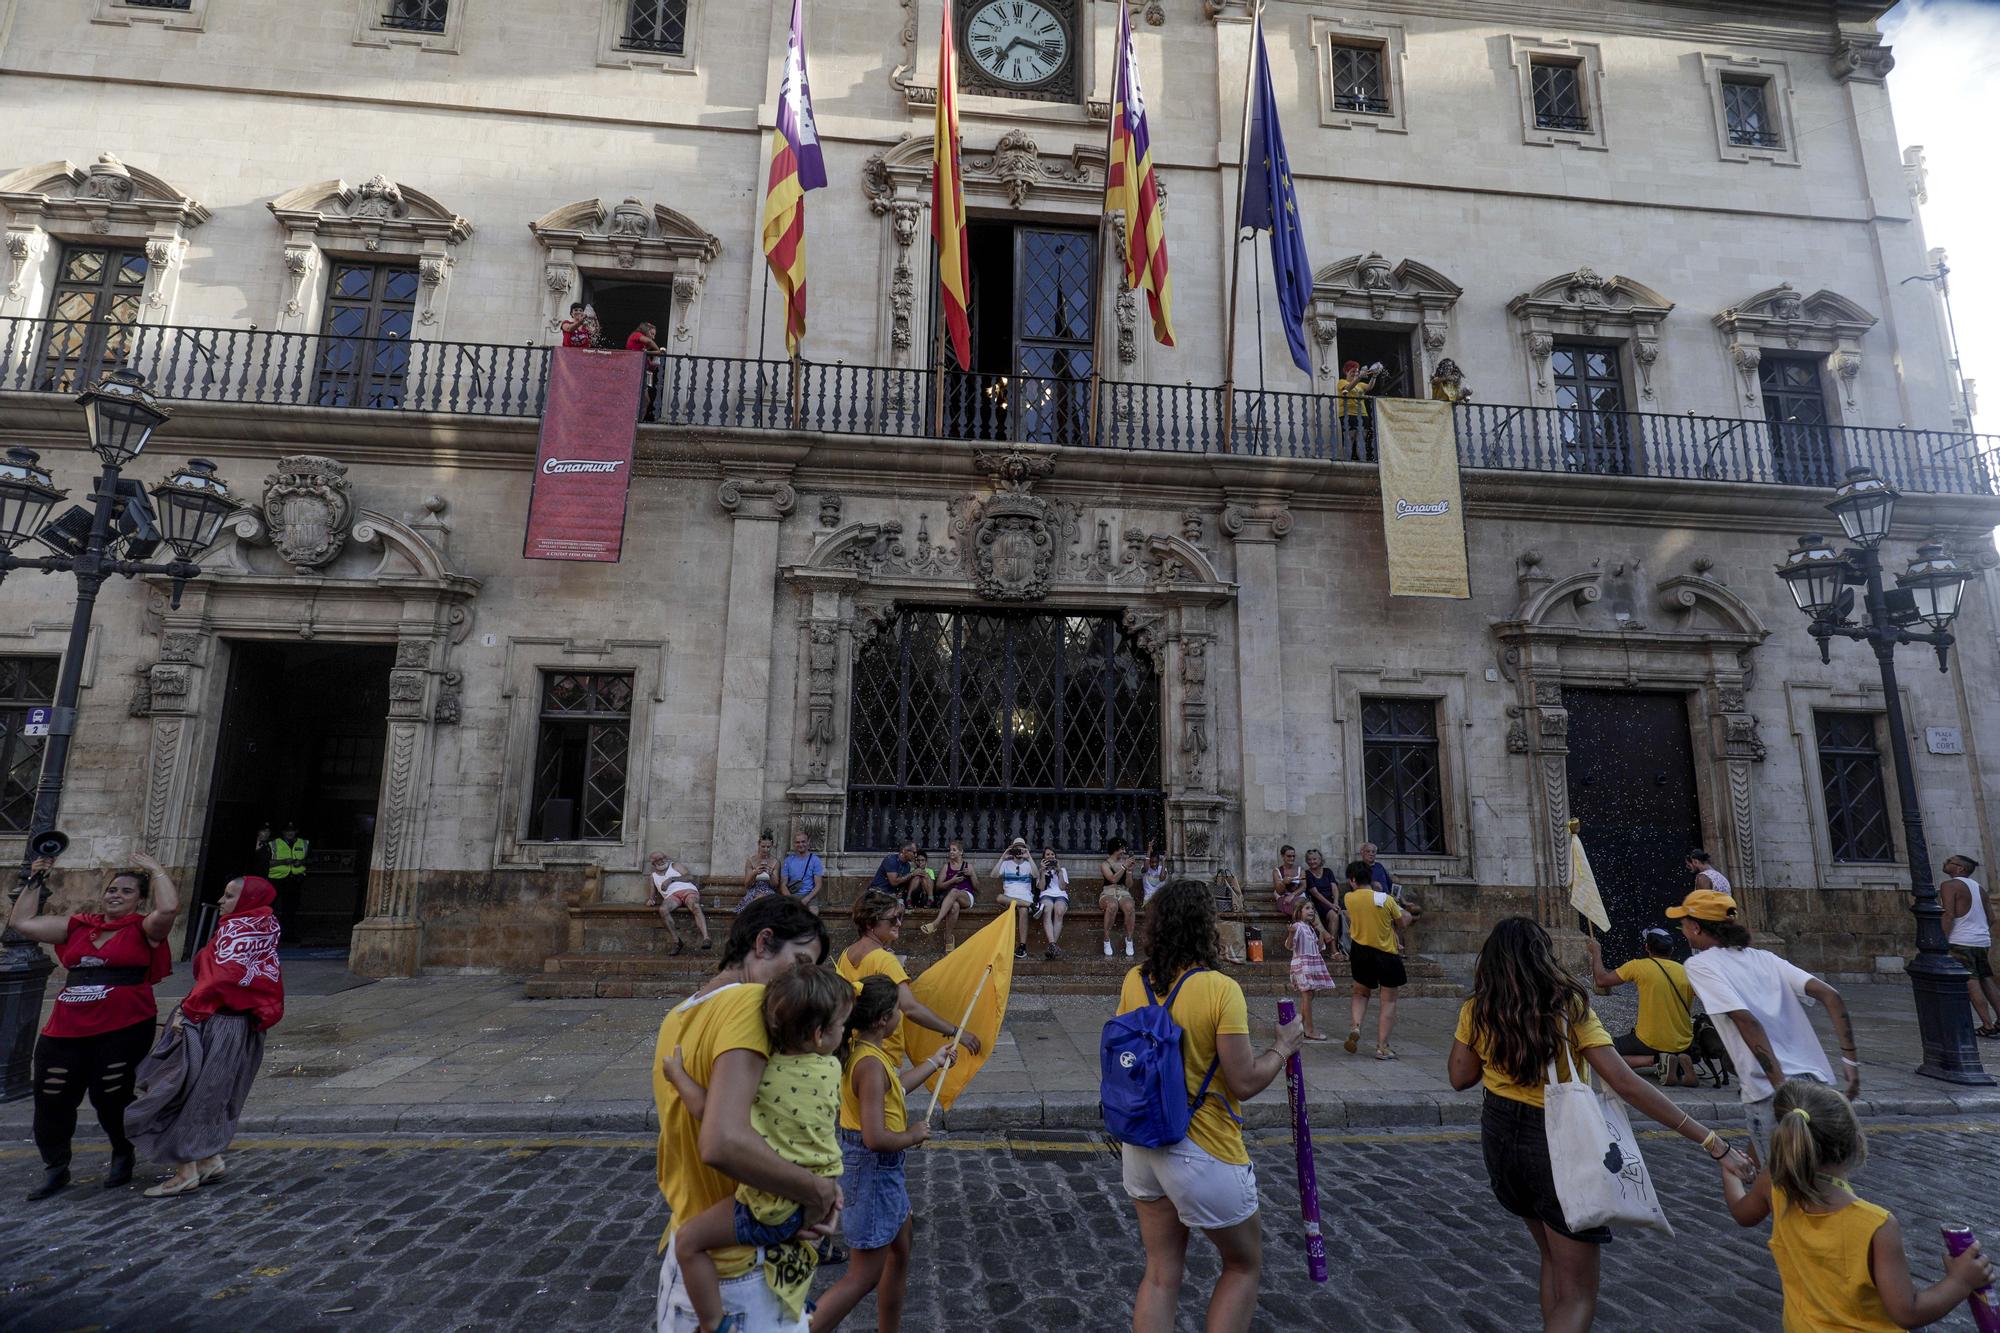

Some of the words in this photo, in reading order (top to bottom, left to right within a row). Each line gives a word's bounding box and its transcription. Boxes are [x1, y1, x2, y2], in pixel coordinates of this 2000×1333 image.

[543, 457, 624, 474] Canamunt
[1396, 499, 1449, 518] Canavall
[32, 726, 38, 734] 2
